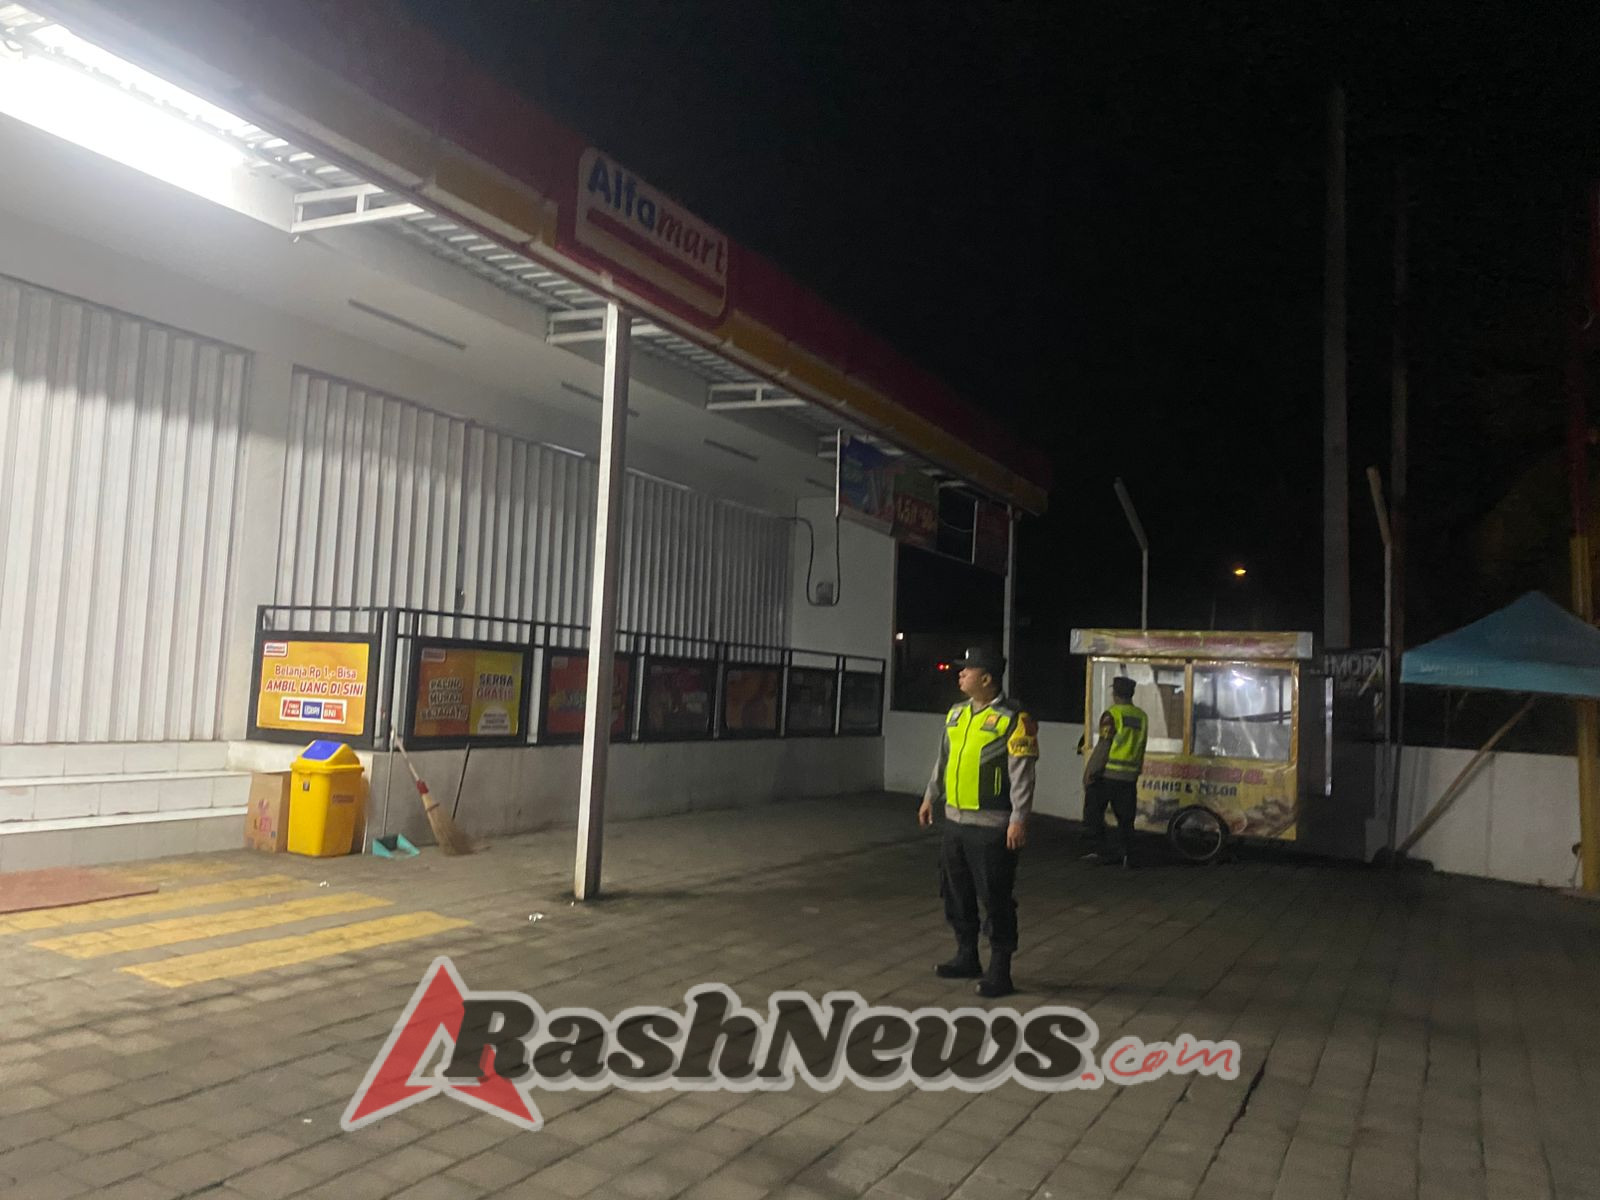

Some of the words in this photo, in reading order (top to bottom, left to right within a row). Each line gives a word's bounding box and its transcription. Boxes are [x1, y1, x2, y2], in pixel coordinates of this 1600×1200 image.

[586, 158, 724, 274] Alfamart
[274, 665, 307, 679] Belanja
[309, 666, 321, 678] Rp
[337, 667, 357, 679] Bisa
[266, 680, 297, 692] AMBIL
[299, 681, 327, 693] UANG
[330, 682, 341, 694] DI
[343, 683, 364, 695] SINI
[324, 709, 336, 717] BNI
